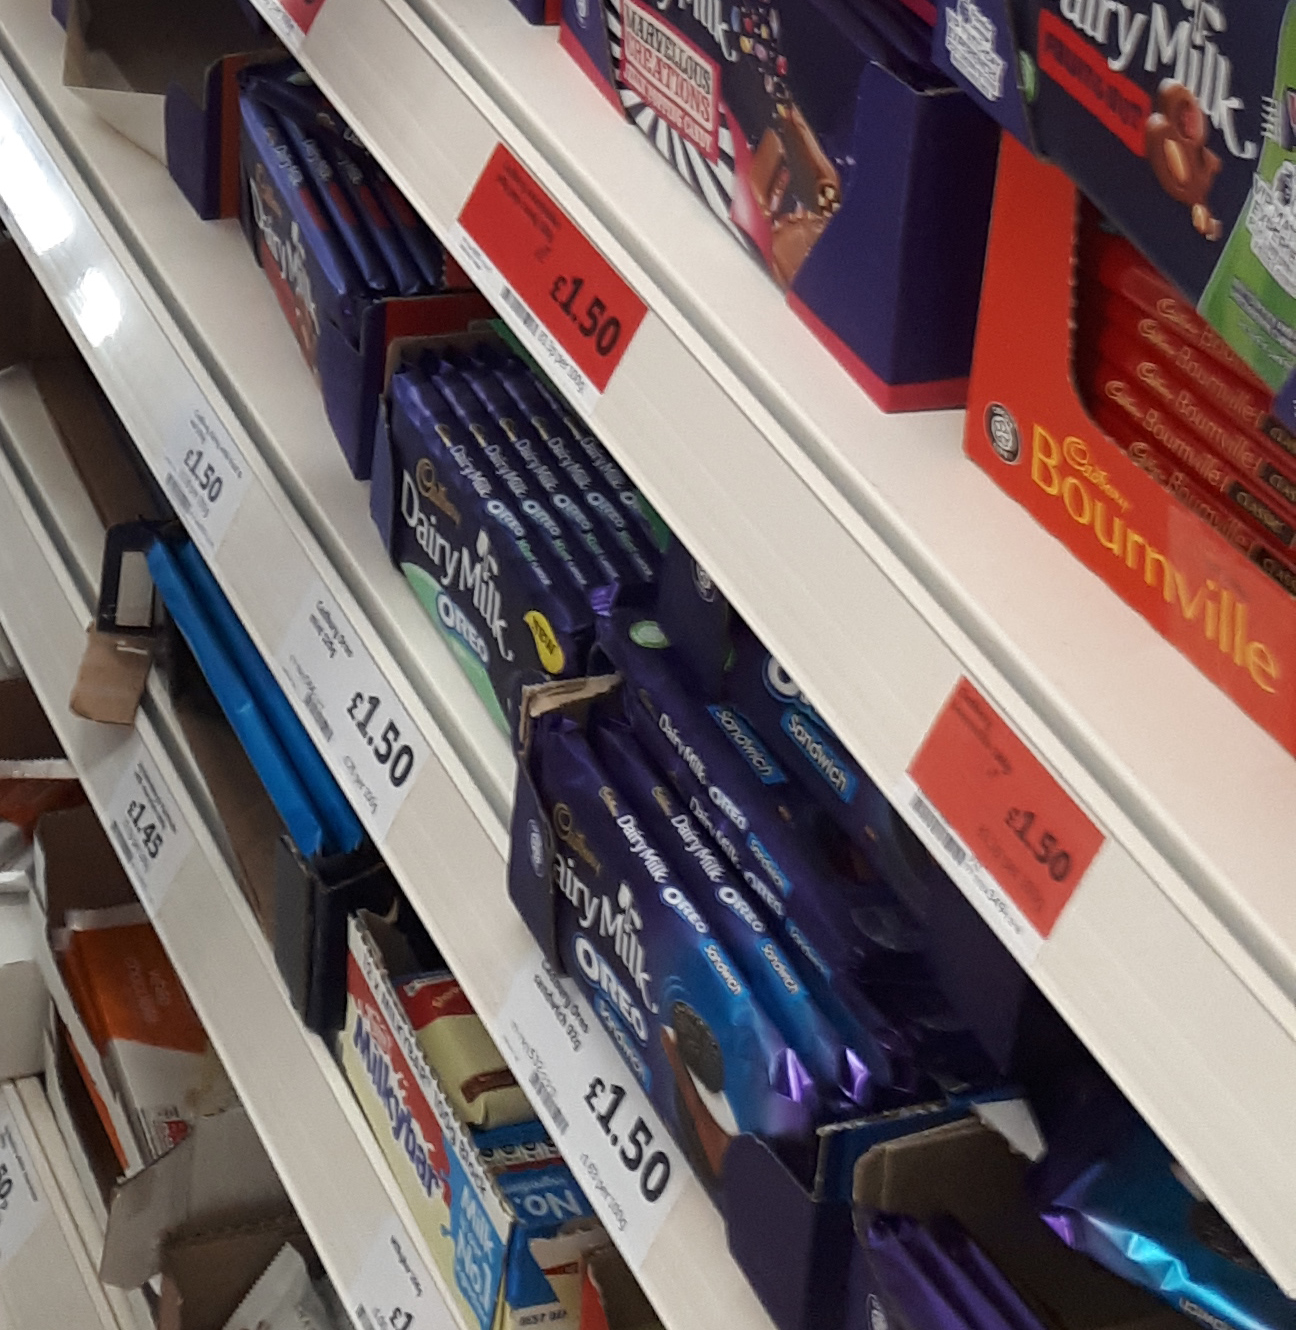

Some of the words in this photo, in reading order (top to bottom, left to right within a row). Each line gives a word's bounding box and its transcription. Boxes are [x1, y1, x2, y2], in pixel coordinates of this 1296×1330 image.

[623, 2, 711, 94] MARVELLOUS
[624, 27, 711, 123] CREATIONS
[549, 275, 622, 357] £1.50
[1176, 346, 1262, 428] Bournville
[1141, 408, 1228, 493] Bournville
[1176, 390, 1263, 473] Bournville
[183, 448, 224, 503] £1.50
[449, 444, 476, 482] Dairy
[469, 470, 493, 499] Milk
[486, 499, 526, 537] OREO
[485, 444, 510, 476] Dairy
[503, 469, 529, 499] Milk
[522, 499, 561, 537] OREO
[515, 438, 540, 471] Dairy
[533, 464, 558, 492] Milk
[554, 493, 593, 531] OREO
[548, 436, 573, 468] Dairy
[586, 491, 627, 529] OREO
[1061, 435, 1133, 514] Cadbury
[1168, 470, 1253, 551] Bournville
[401, 468, 460, 587] Dairy
[458, 541, 515, 663] Milk
[1031, 423, 1280, 695] Bournville
[316, 599, 340, 641] Cadbury
[337, 634, 354, 659] Oreo
[436, 592, 490, 663] OREO
[346, 691, 414, 788] £1.50
[658, 712, 687, 754] Dairy
[680, 743, 708, 785] Milk
[708, 785, 749, 831] OREO
[715, 709, 775, 777] Sandwich
[786, 713, 848, 793] Sandwich
[126, 799, 164, 860] £1.45
[552, 802, 601, 877] Cadbury
[1005, 806, 1072, 883] £1.50
[552, 851, 602, 929] airy
[600, 889, 661, 1015] Milk
[616, 813, 648, 854] Dairy
[640, 843, 670, 884] Milk
[661, 886, 709, 934] OREO
[704, 943, 742, 996] Sandwich
[670, 813, 701, 854] Dairy
[695, 842, 726, 883] Milk
[716, 885, 766, 934] OREO
[761, 943, 800, 995] Sandwich
[743, 870, 785, 917] OREO
[534, 973, 567, 1028] sandwich
[564, 1020, 582, 1053] 92g
[568, 993, 590, 1035] Oreo
[574, 936, 650, 1042] OREO
[353, 1013, 442, 1199] Milkybar
[583, 1075, 672, 1203] £1.50
